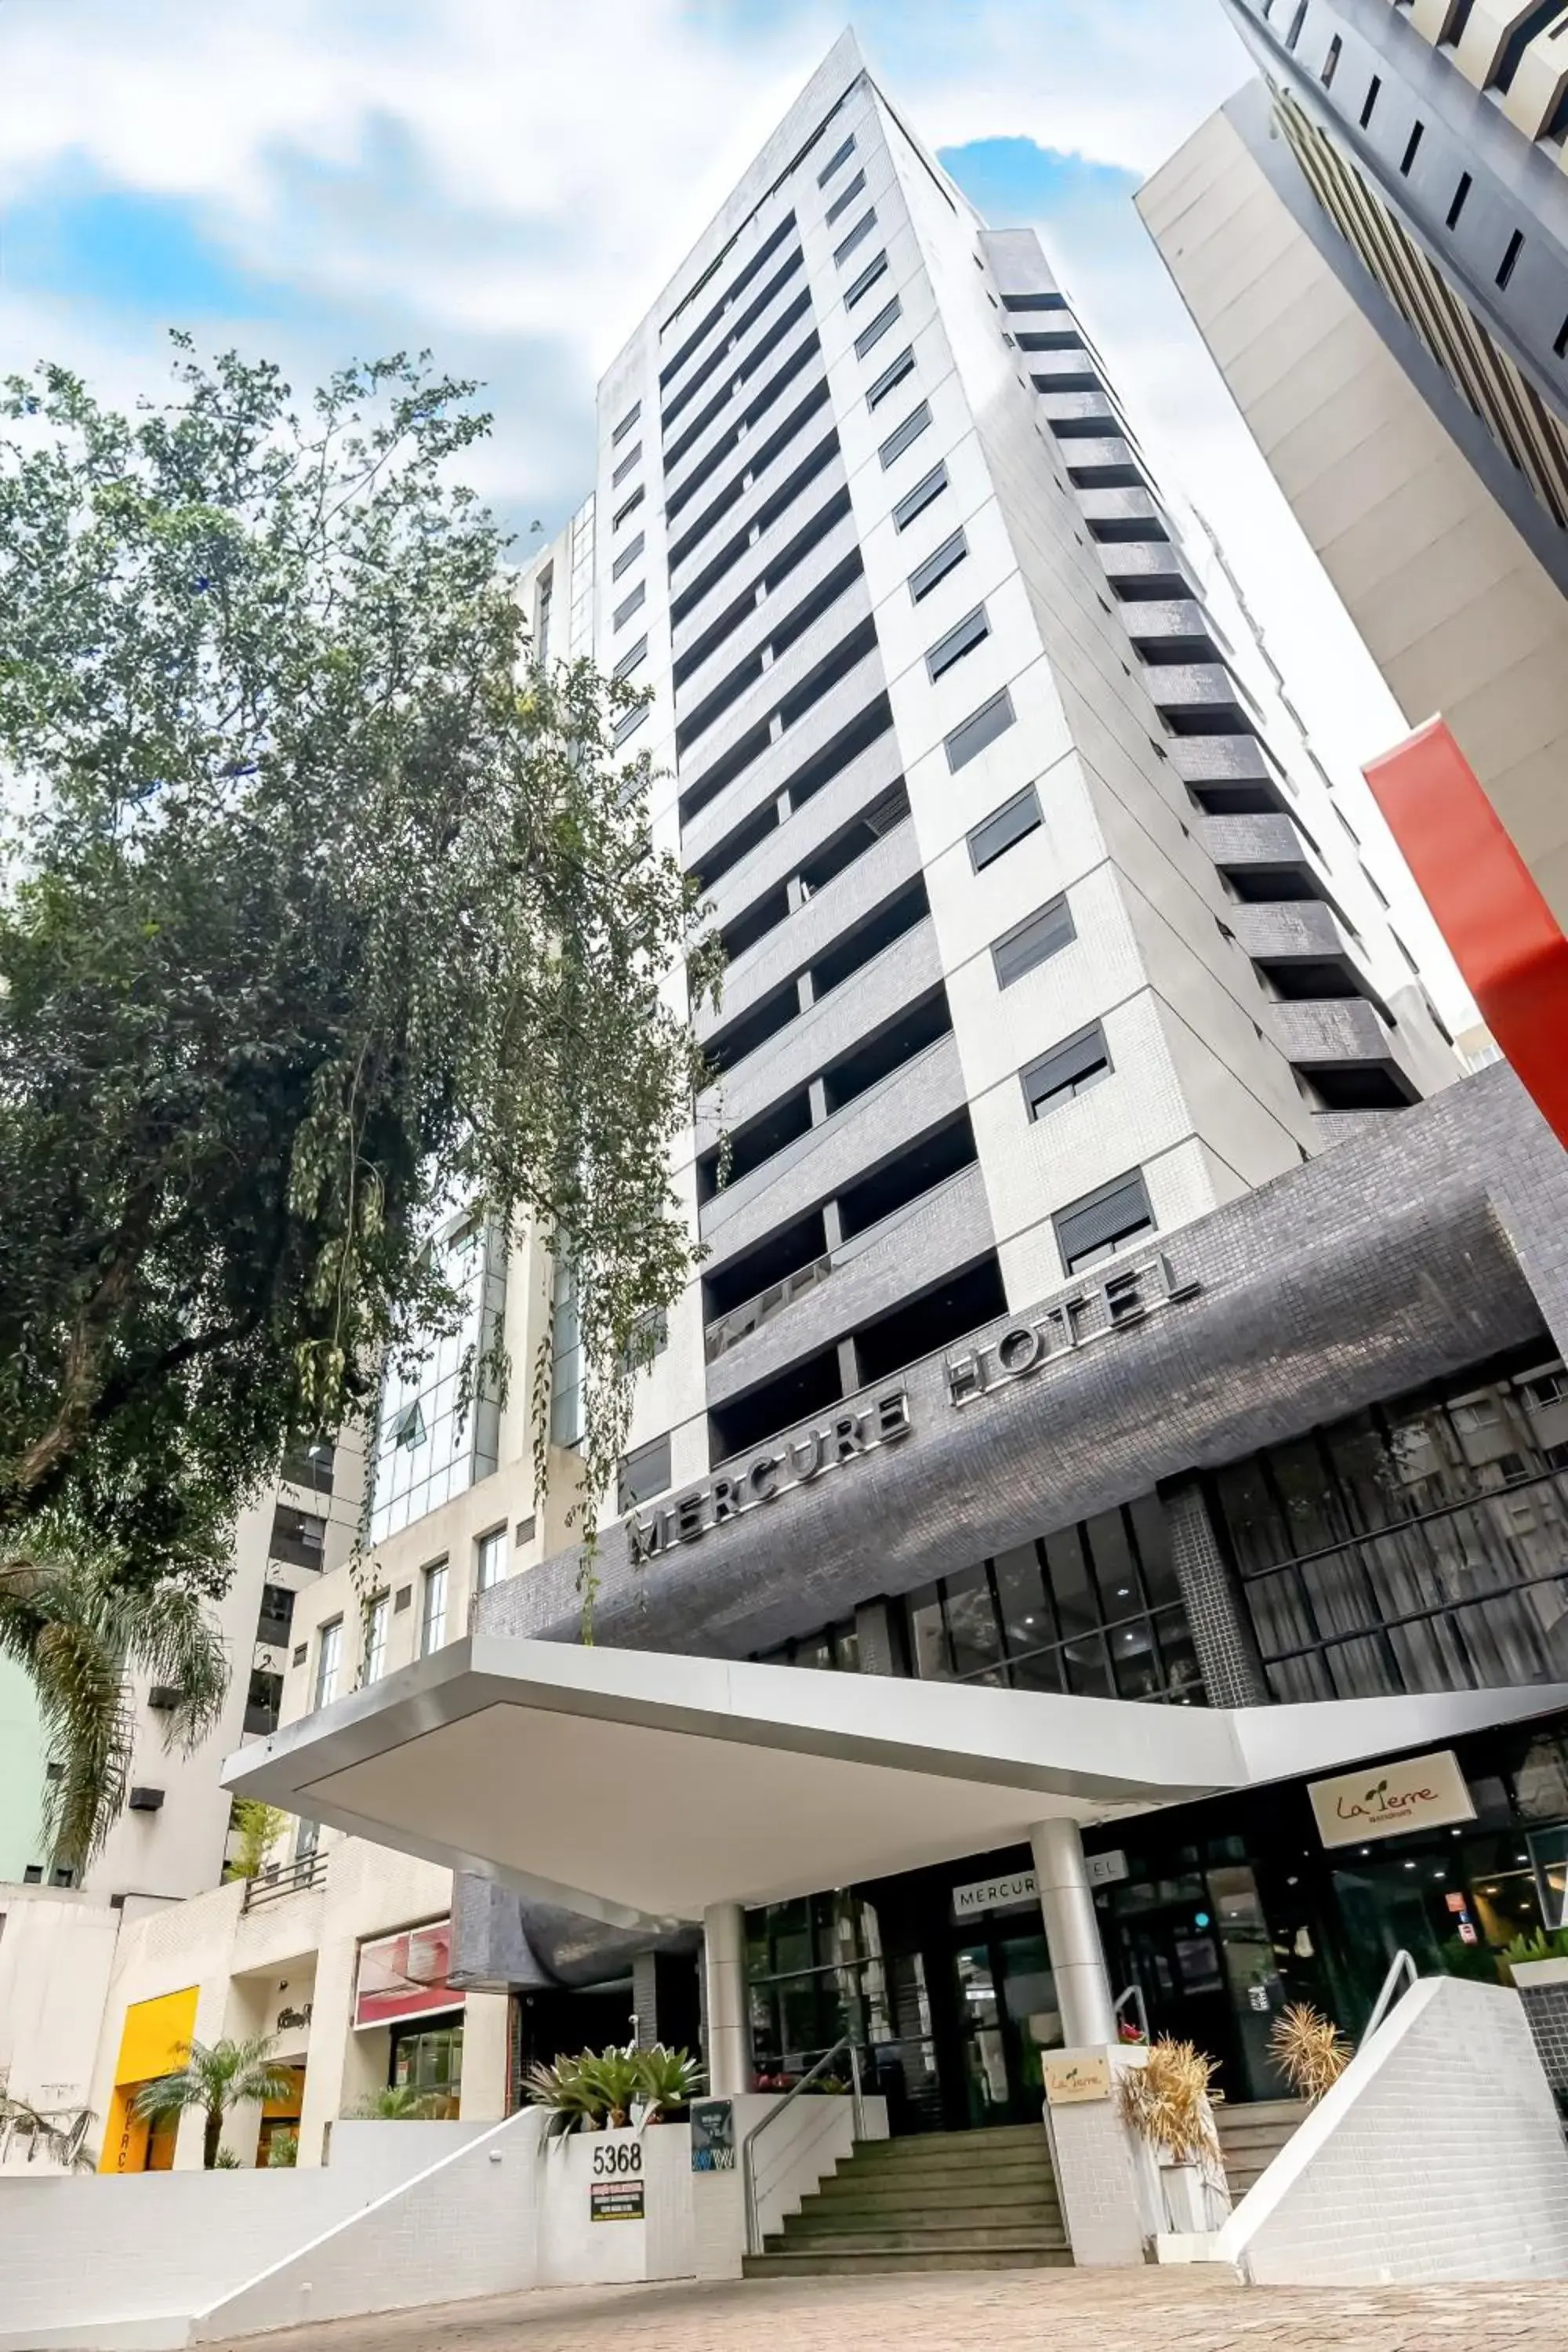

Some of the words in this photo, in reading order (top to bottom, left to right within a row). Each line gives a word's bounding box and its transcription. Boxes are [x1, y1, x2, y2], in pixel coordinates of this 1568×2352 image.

[628, 1387, 911, 1563] MERCURE
[943, 1252, 1202, 1406] HOTEL
[1337, 1796, 1370, 1820] La
[1366, 1780, 1439, 1812] Terre
[960, 1878, 1036, 1907] MERCUR
[593, 2143, 641, 2175] 5368
